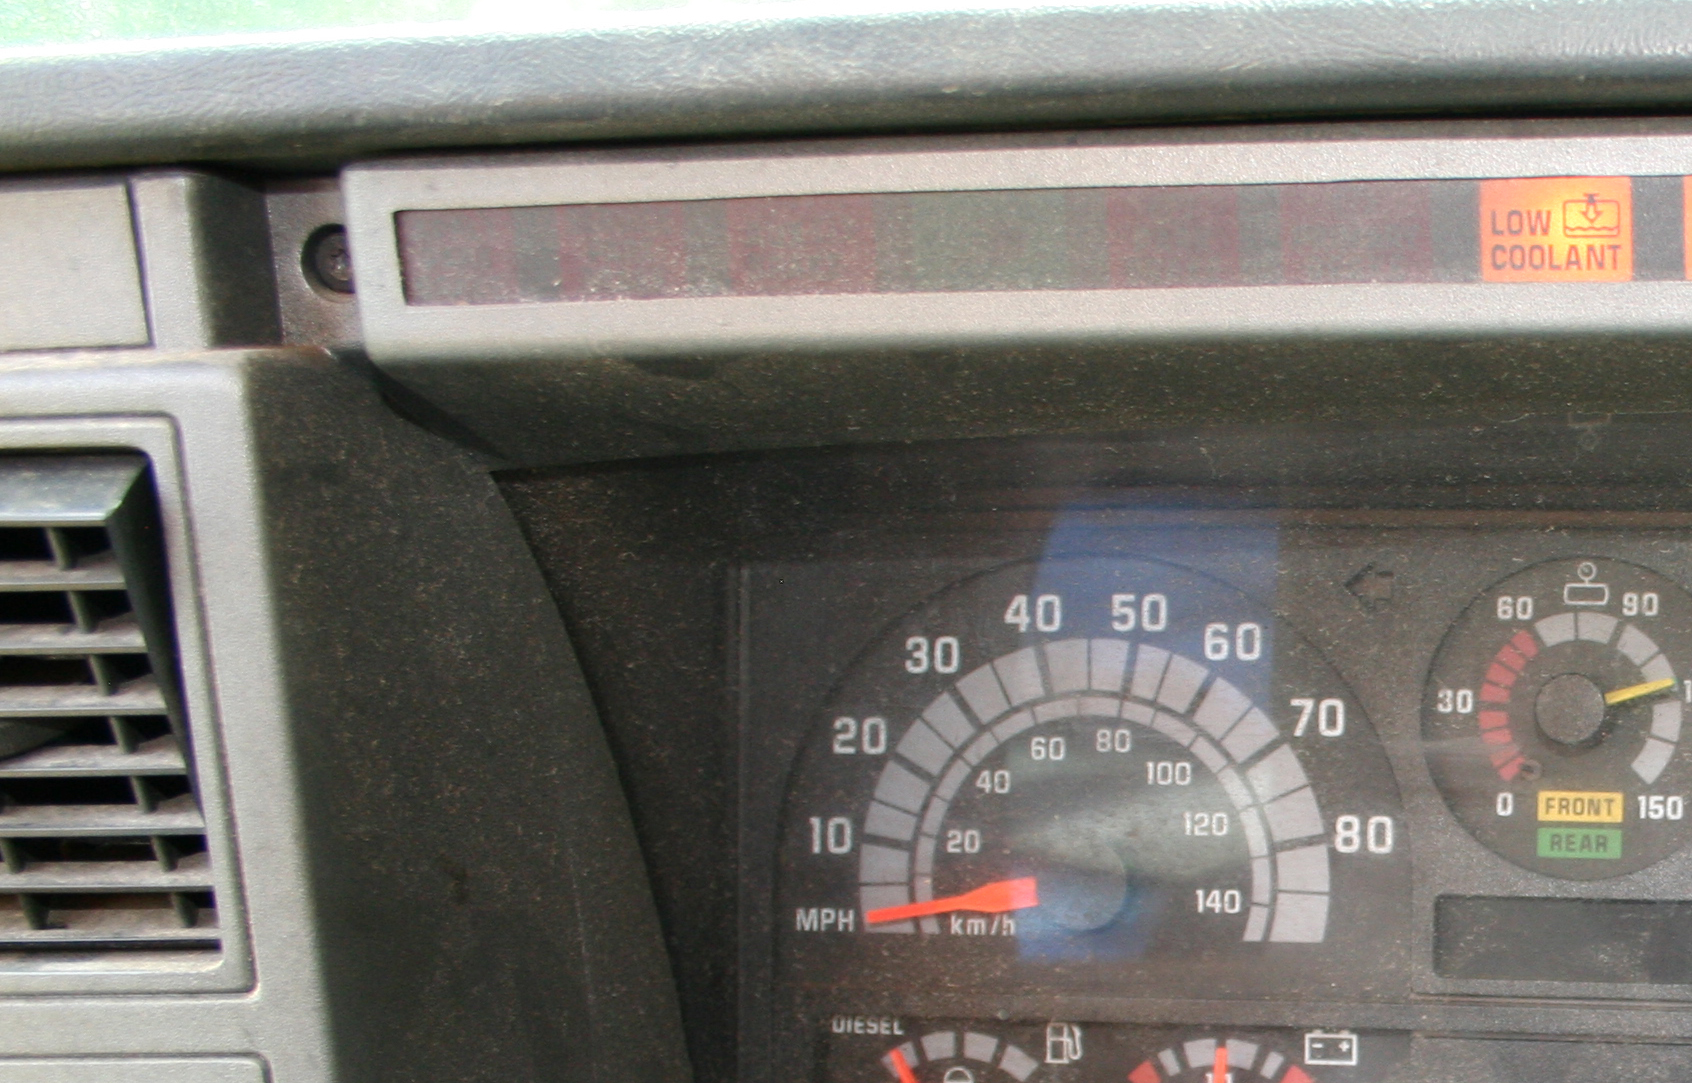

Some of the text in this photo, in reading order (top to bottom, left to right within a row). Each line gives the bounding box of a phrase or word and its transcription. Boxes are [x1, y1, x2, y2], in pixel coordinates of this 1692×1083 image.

[1490, 208, 1552, 237] LOW
[1490, 243, 1622, 271] COOLANT
[1004, 594, 1063, 634] 40
[1110, 593, 1169, 633] 50
[1496, 595, 1534, 621] 60
[1622, 592, 1660, 617] 90
[904, 636, 961, 675] 30
[1203, 623, 1263, 662] 60
[1436, 688, 1474, 714] 30
[1289, 698, 1347, 738] 70
[832, 717, 889, 756] 20
[1029, 736, 1067, 762] 60
[1094, 729, 1132, 755] 80
[975, 769, 1012, 796] 40
[1145, 760, 1193, 787] 100
[1495, 791, 1514, 817] 0
[1544, 796, 1617, 816] FRONT
[1637, 795, 1684, 820] 150
[808, 816, 854, 855] 10
[1182, 812, 1229, 838] 120
[1334, 815, 1394, 855] 80
[945, 829, 982, 856] 20
[1549, 833, 1609, 852] REAR
[1194, 889, 1242, 916] 140
[795, 908, 857, 934] MPH
[949, 912, 1017, 937] km/h
[831, 1014, 906, 1036] DIESEL
